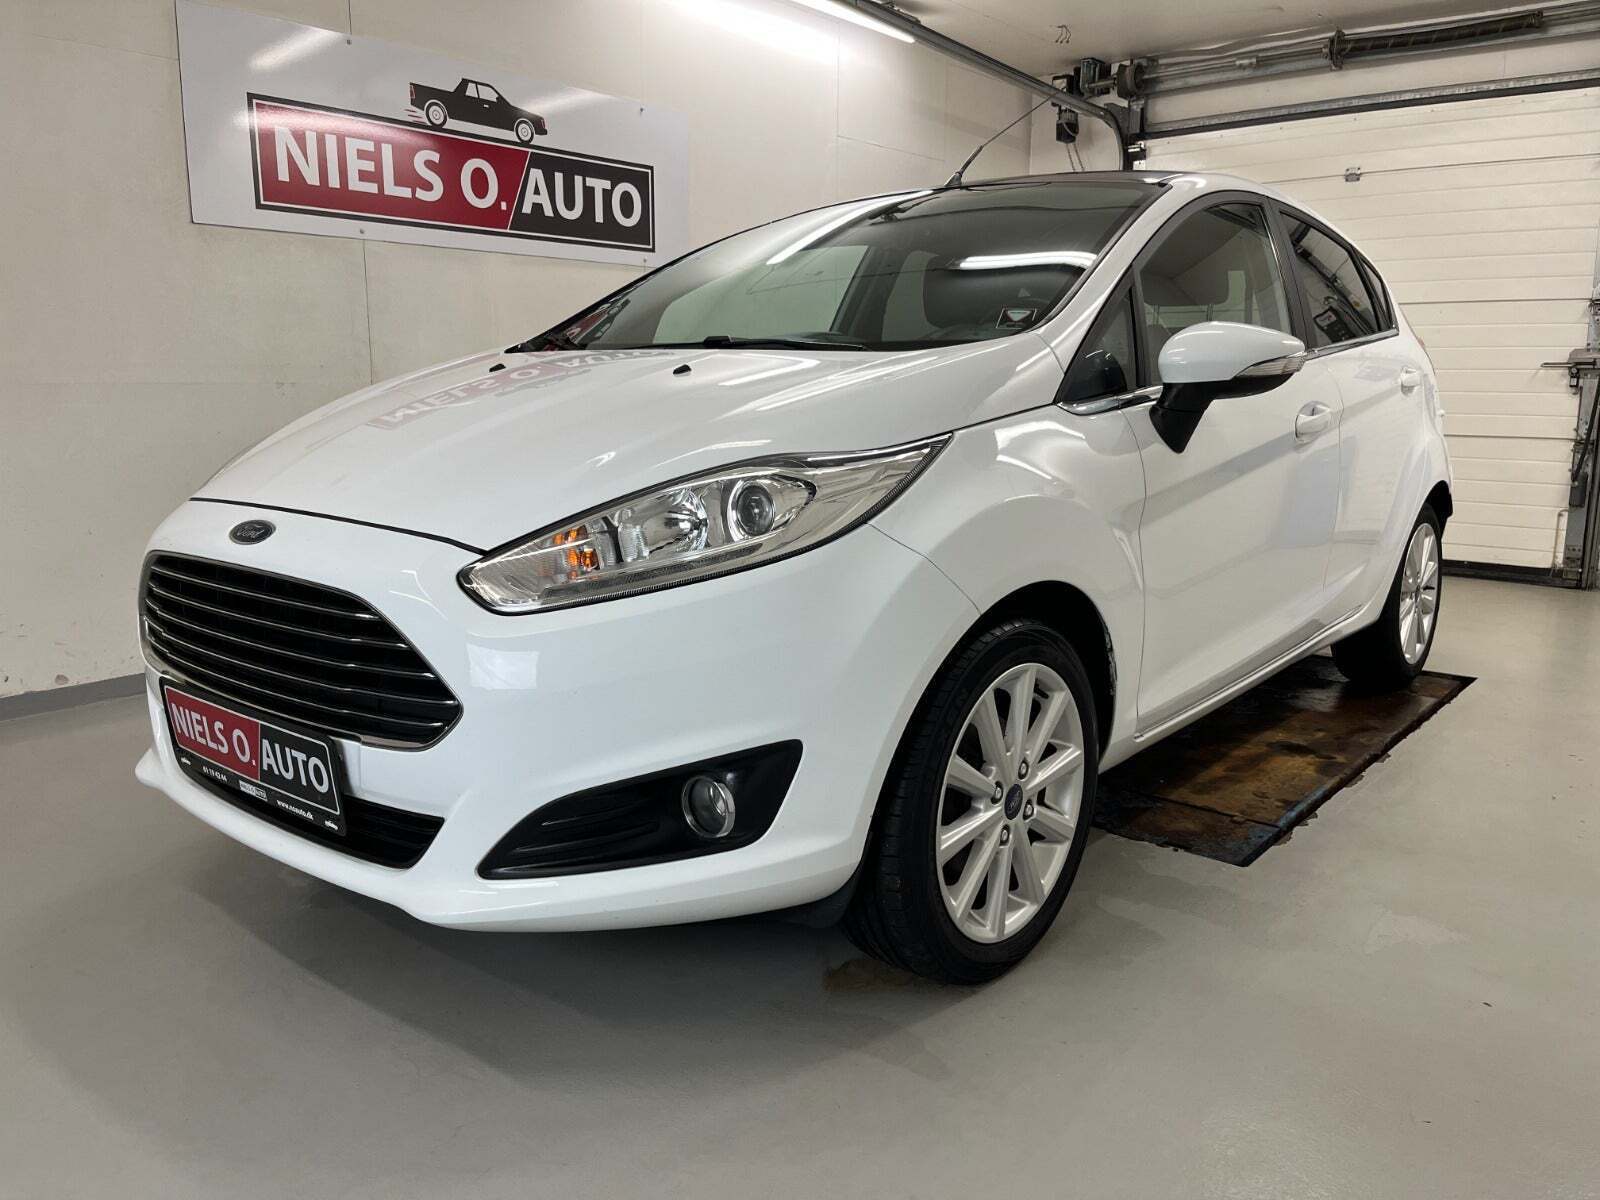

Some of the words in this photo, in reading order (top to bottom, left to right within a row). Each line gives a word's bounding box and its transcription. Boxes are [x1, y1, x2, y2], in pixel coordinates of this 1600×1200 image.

[274, 125, 444, 202] NIELS
[460, 157, 508, 211] O.
[522, 166, 643, 228] AUTO
[171, 703, 229, 754] NIELS
[232, 728, 256, 766] O.
[262, 738, 330, 794] AUTO
